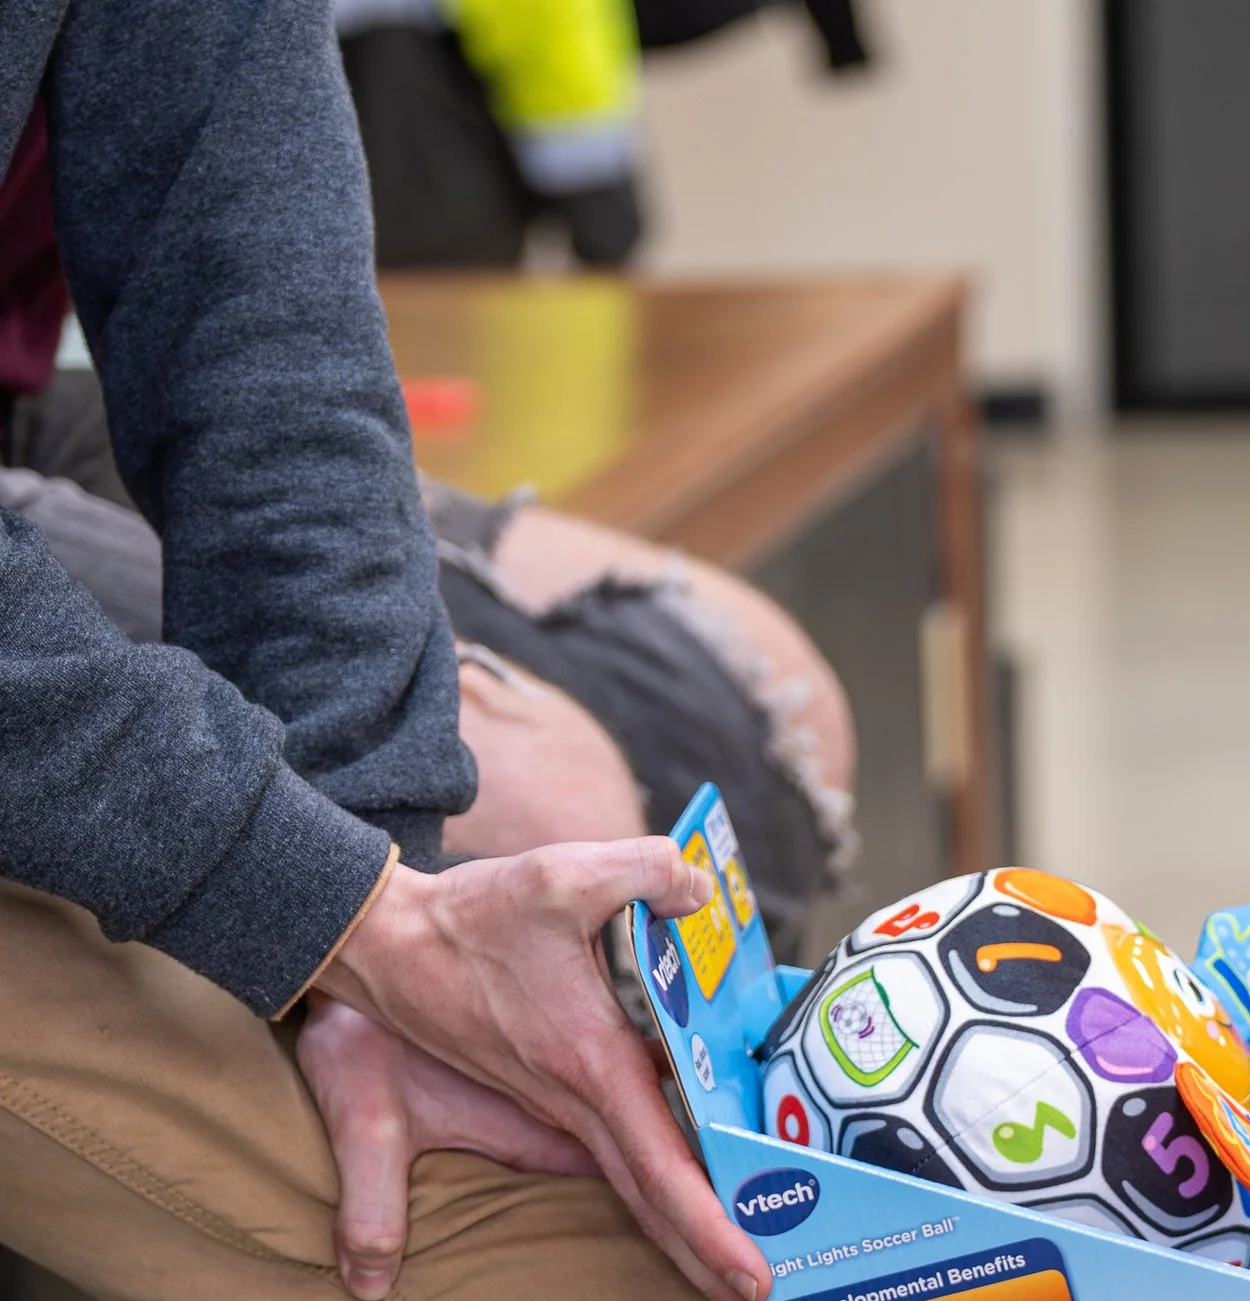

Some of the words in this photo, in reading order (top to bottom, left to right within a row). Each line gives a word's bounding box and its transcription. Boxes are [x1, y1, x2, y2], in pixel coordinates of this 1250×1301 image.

[1143, 1112, 1210, 1199] 5
[770, 1257, 804, 1278] ight
[807, 1243, 858, 1267] Lights
[861, 1227, 918, 1253] Soccer
[947, 1254, 1026, 1285] Benefits
